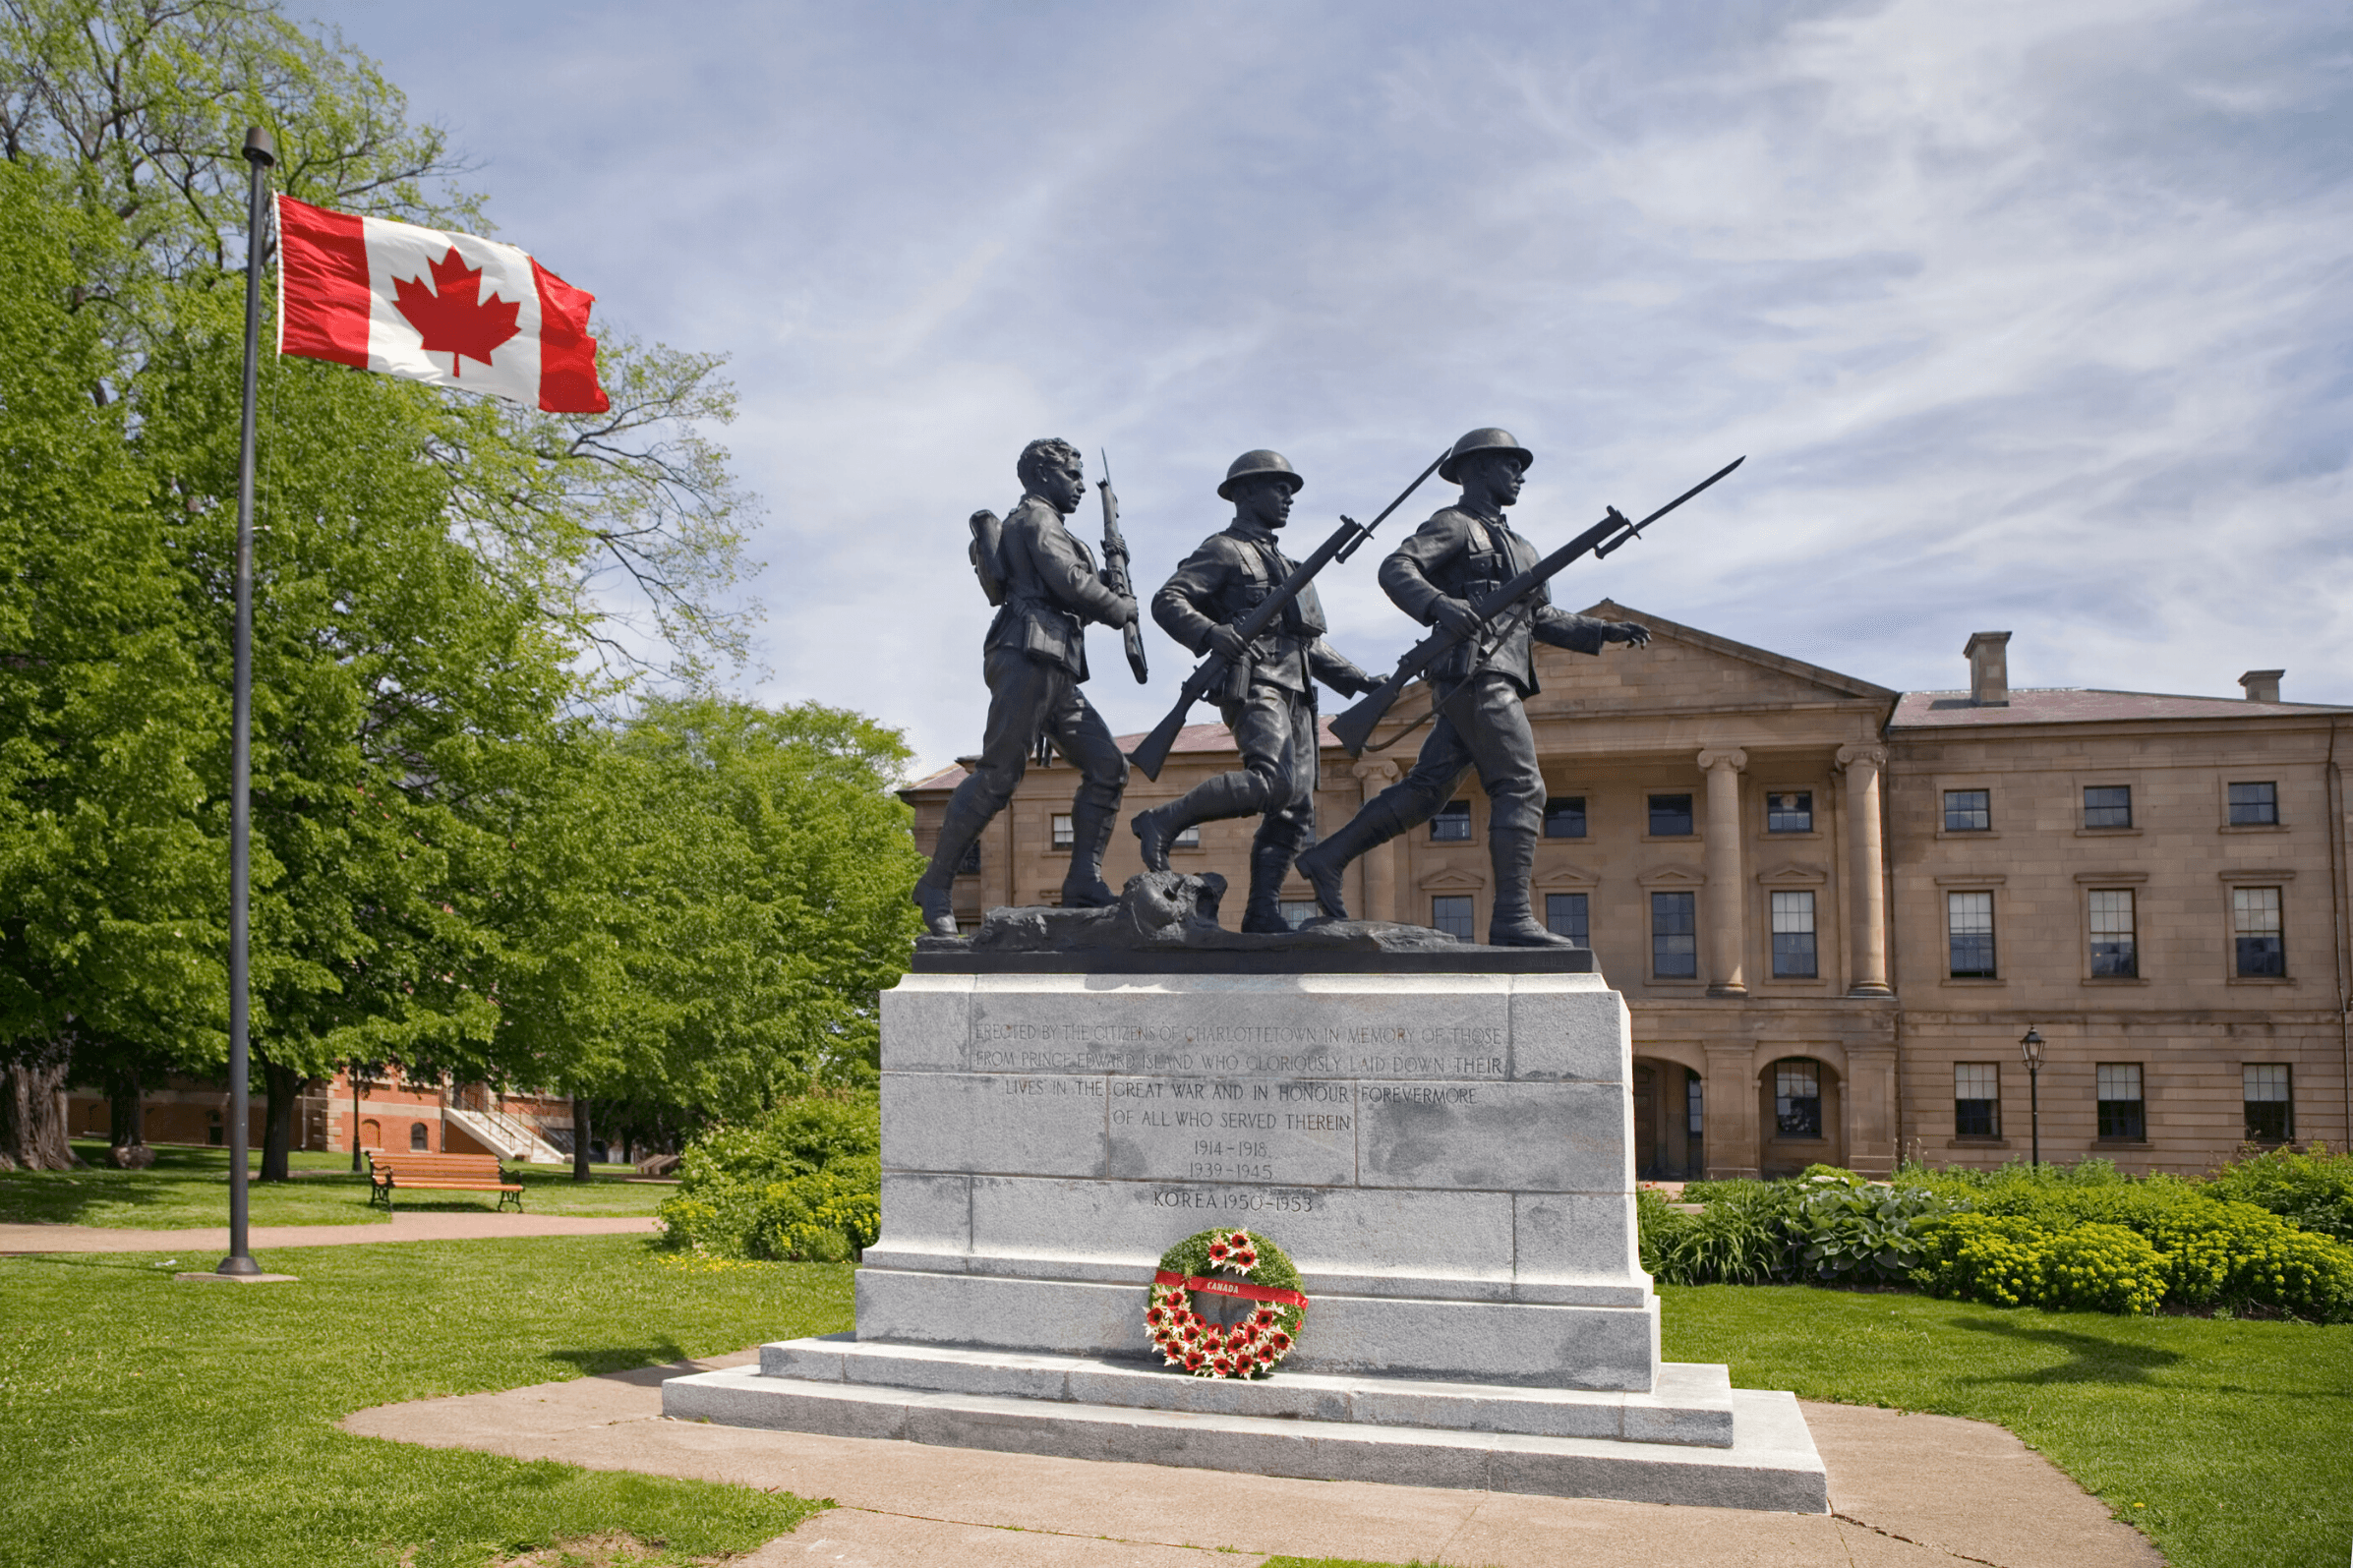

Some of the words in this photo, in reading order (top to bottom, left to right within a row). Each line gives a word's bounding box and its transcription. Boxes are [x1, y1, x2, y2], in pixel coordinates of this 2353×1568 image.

[975, 1024, 1036, 1040] ERECTED
[1042, 1024, 1059, 1040] BY
[1062, 1024, 1088, 1041] THE
[1093, 1025, 1154, 1042] CITIZENS
[1159, 1025, 1178, 1042] OF
[1184, 1025, 1316, 1043] CHARLOTTETOWN
[1324, 1027, 1339, 1043] IN
[1347, 1027, 1414, 1044] MEMORY
[1422, 1027, 1444, 1044] OF
[1451, 1027, 1501, 1044] THOSE
[975, 1051, 1015, 1067] FROM
[1022, 1052, 1072, 1068] PRINCE
[1077, 1052, 1136, 1069] EDWARD
[1143, 1054, 1193, 1070] ISLAND
[1202, 1054, 1239, 1071] WHO
[1246, 1055, 1341, 1073] GLORIOUSLY
[1350, 1056, 1384, 1073] LAID
[1393, 1057, 1444, 1074] DOWN
[1455, 1057, 1502, 1074] THEIR
[1005, 1080, 1044, 1096] LIVES
[1052, 1081, 1066, 1096] IN
[1076, 1081, 1103, 1097] THE
[1113, 1082, 1163, 1098] GREAT
[1172, 1083, 1205, 1099] WAR
[1212, 1084, 1244, 1100] AND
[1253, 1084, 1268, 1101] IN
[1279, 1085, 1349, 1103] HONOUR
[1361, 1086, 1477, 1104] FOREVERMORE
[1113, 1110, 1134, 1126] OF
[1142, 1111, 1170, 1127] ALL
[1176, 1111, 1212, 1128] WHO
[1219, 1112, 1276, 1130] SERVED
[1286, 1114, 1350, 1131] THEREIN
[1153, 1191, 1217, 1209] KOREA
[1224, 1194, 1313, 1212] 1950-1953
[1206, 1281, 1239, 1294] CANADA
